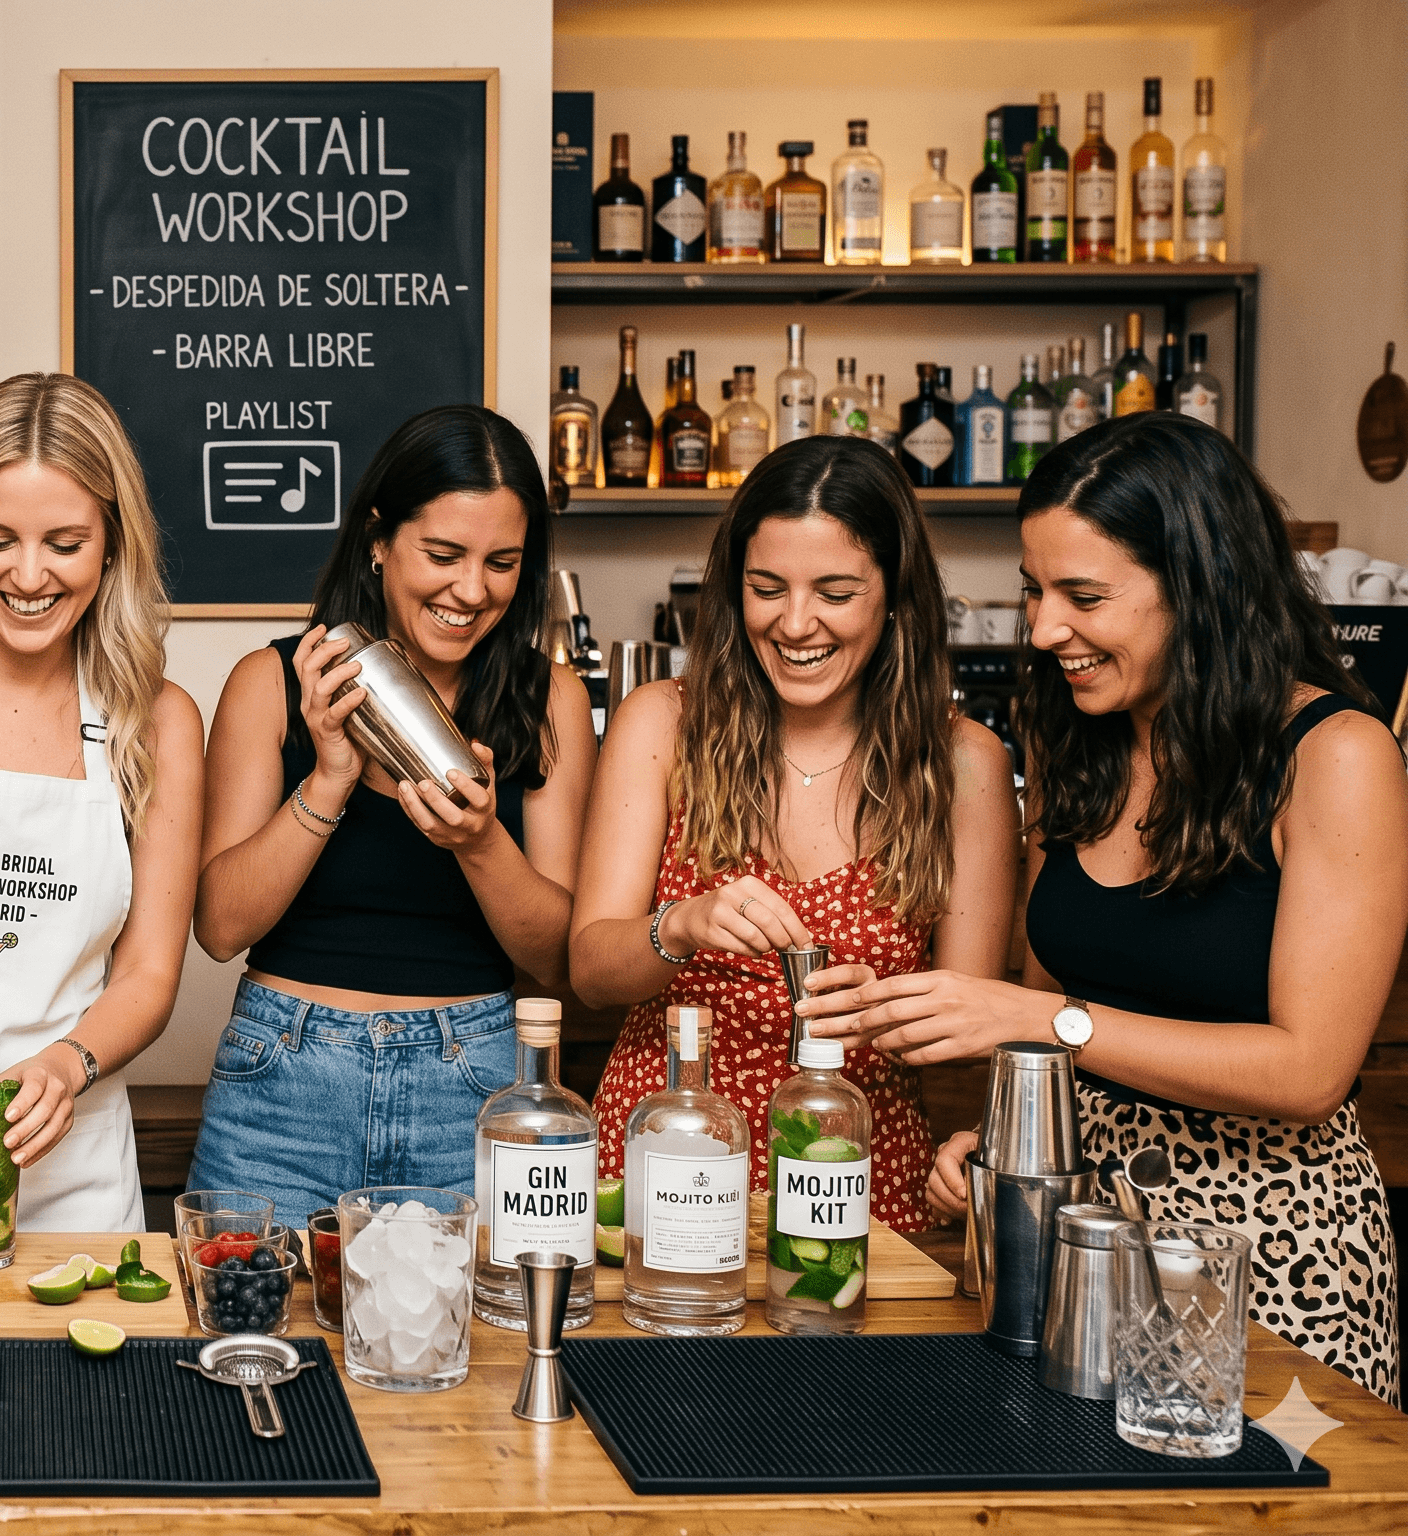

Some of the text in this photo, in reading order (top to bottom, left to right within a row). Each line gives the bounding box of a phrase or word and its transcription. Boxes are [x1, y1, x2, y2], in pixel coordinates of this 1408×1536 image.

[141, 110, 410, 177] COCKTAIL
[152, 190, 409, 243] WORKSHOP
[278, 275, 312, 307] DE
[289, 332, 375, 368] LIBRE
[205, 400, 333, 430] PLAYLIST
[1, 853, 56, 876] BRIDAL
[528, 1166, 567, 1189] GIN
[787, 1172, 865, 1197] MOJITO
[503, 1190, 588, 1217] MADRID
[656, 1190, 713, 1204] MOJITO
[811, 1202, 848, 1224] KIT
